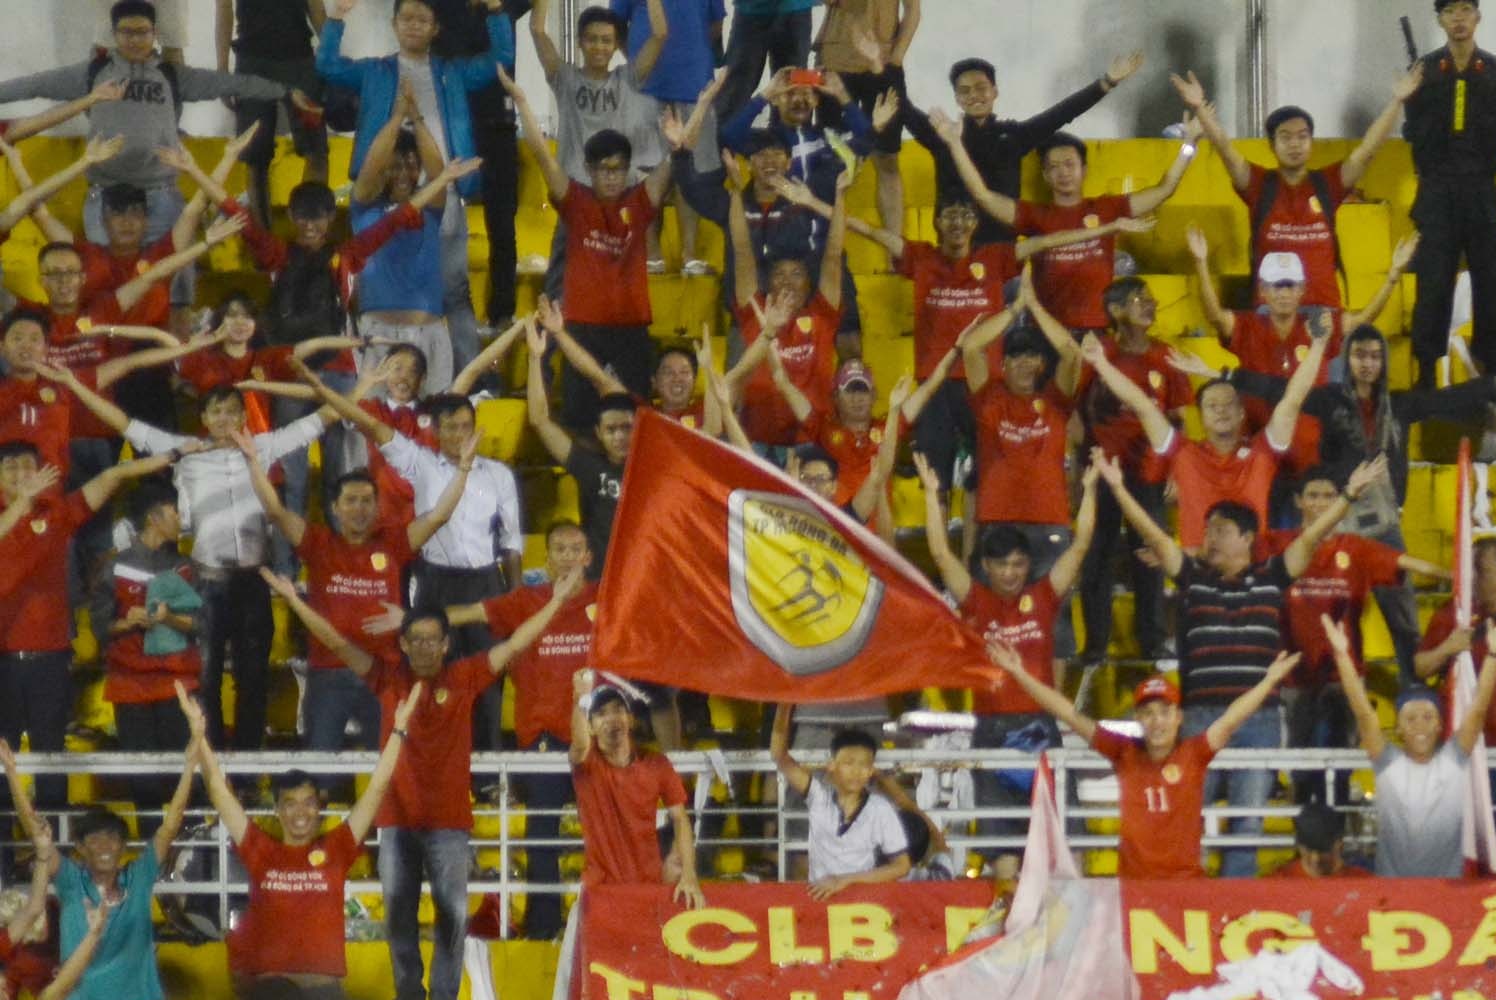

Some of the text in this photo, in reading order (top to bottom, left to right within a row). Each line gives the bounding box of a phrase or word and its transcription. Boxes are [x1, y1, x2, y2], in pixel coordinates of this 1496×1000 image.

[122, 80, 165, 104] ANS
[1143, 786, 1179, 813] 11
[661, 903, 900, 966] CLB
